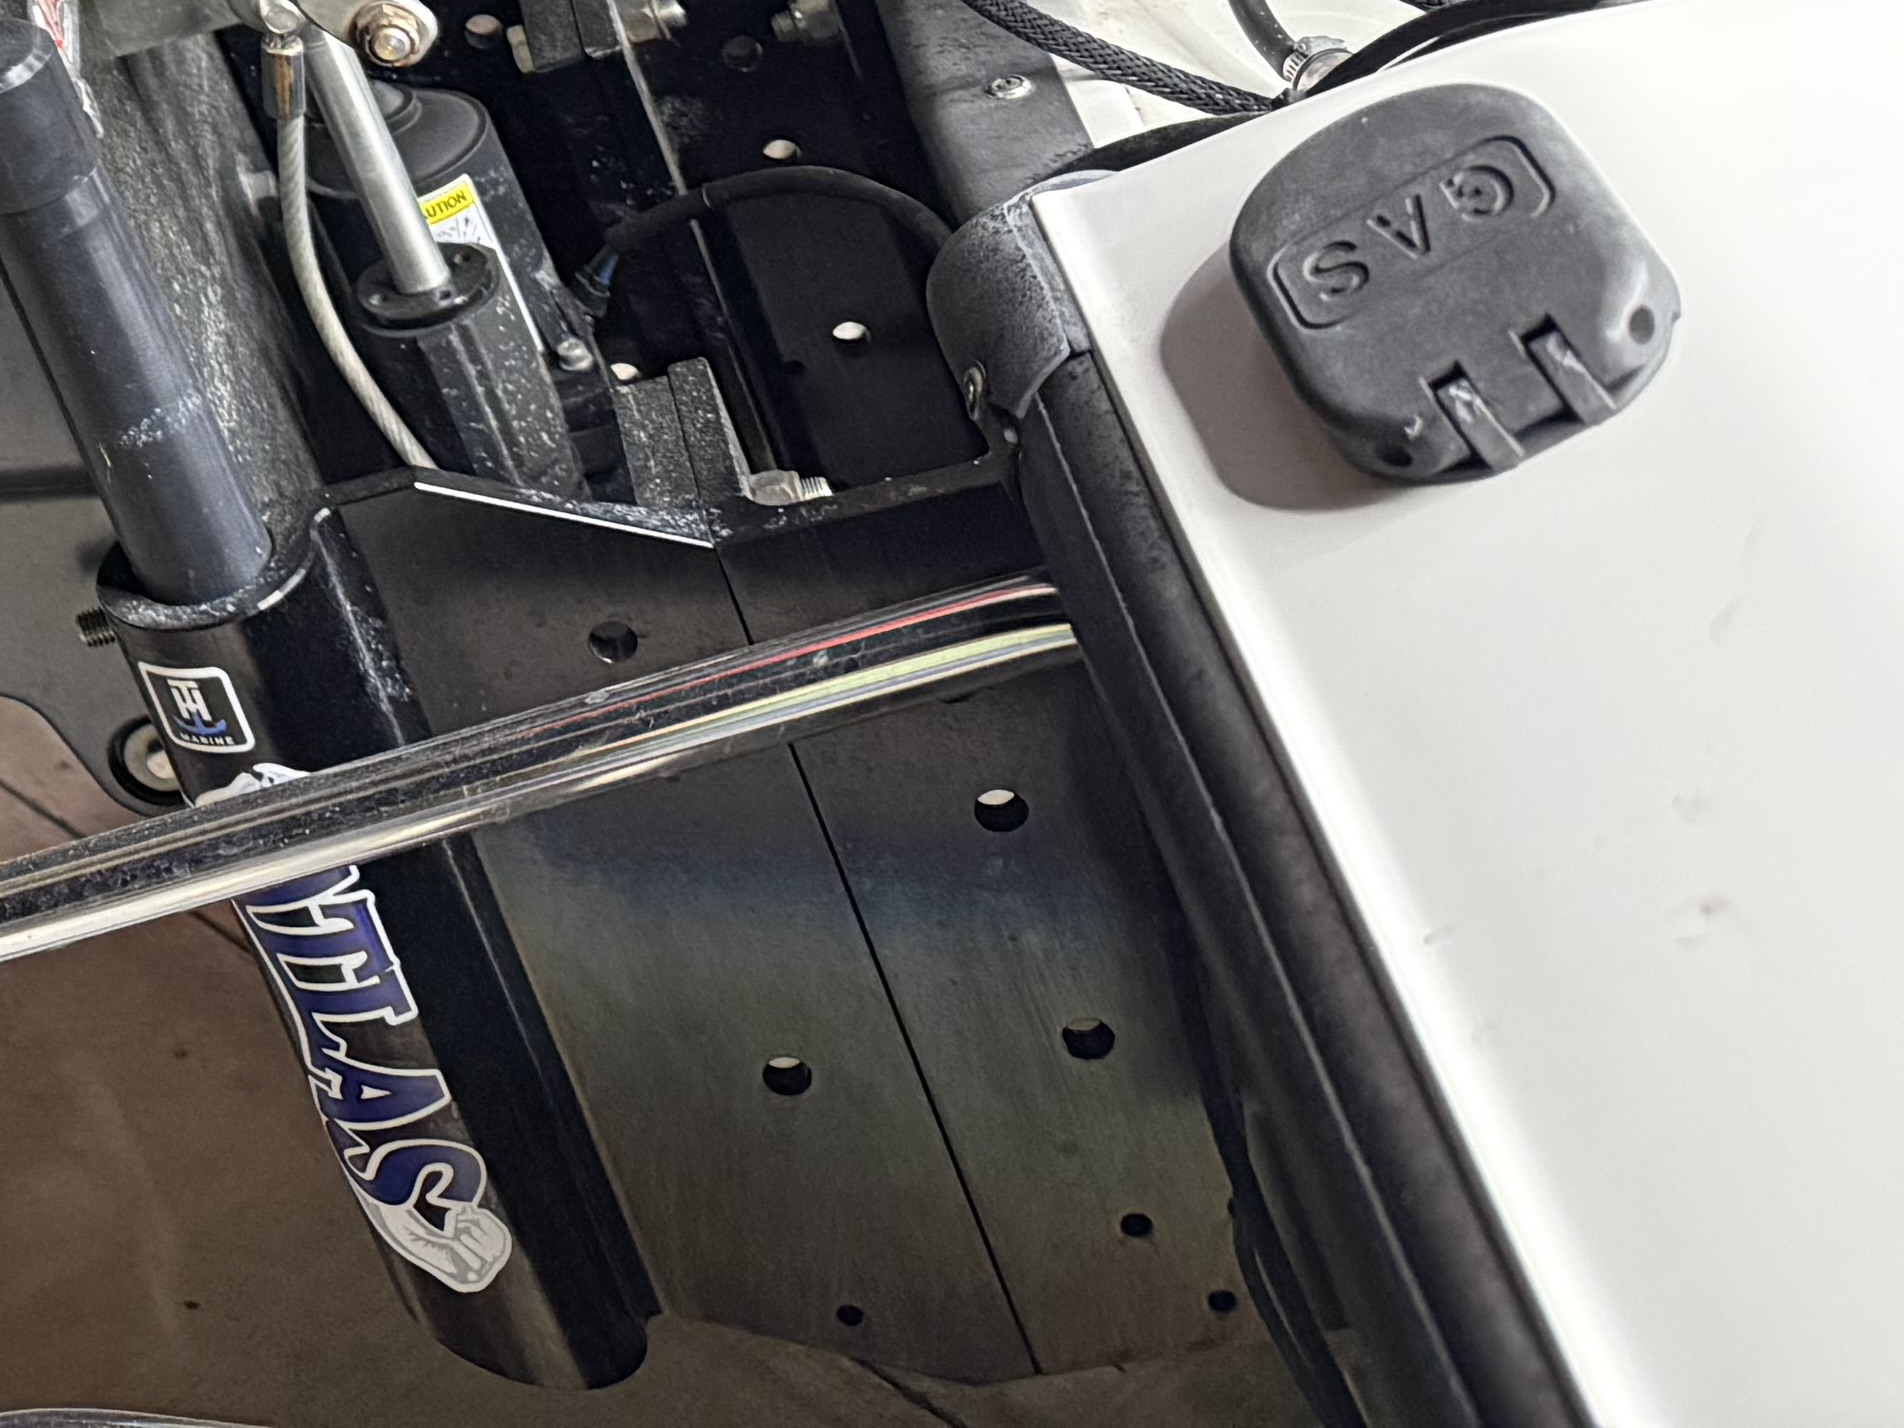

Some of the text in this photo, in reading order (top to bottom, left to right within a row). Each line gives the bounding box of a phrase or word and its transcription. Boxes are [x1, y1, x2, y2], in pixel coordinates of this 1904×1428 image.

[424, 189, 468, 219] UTION
[1302, 164, 1515, 303] GAS
[179, 732, 235, 745] MARINE
